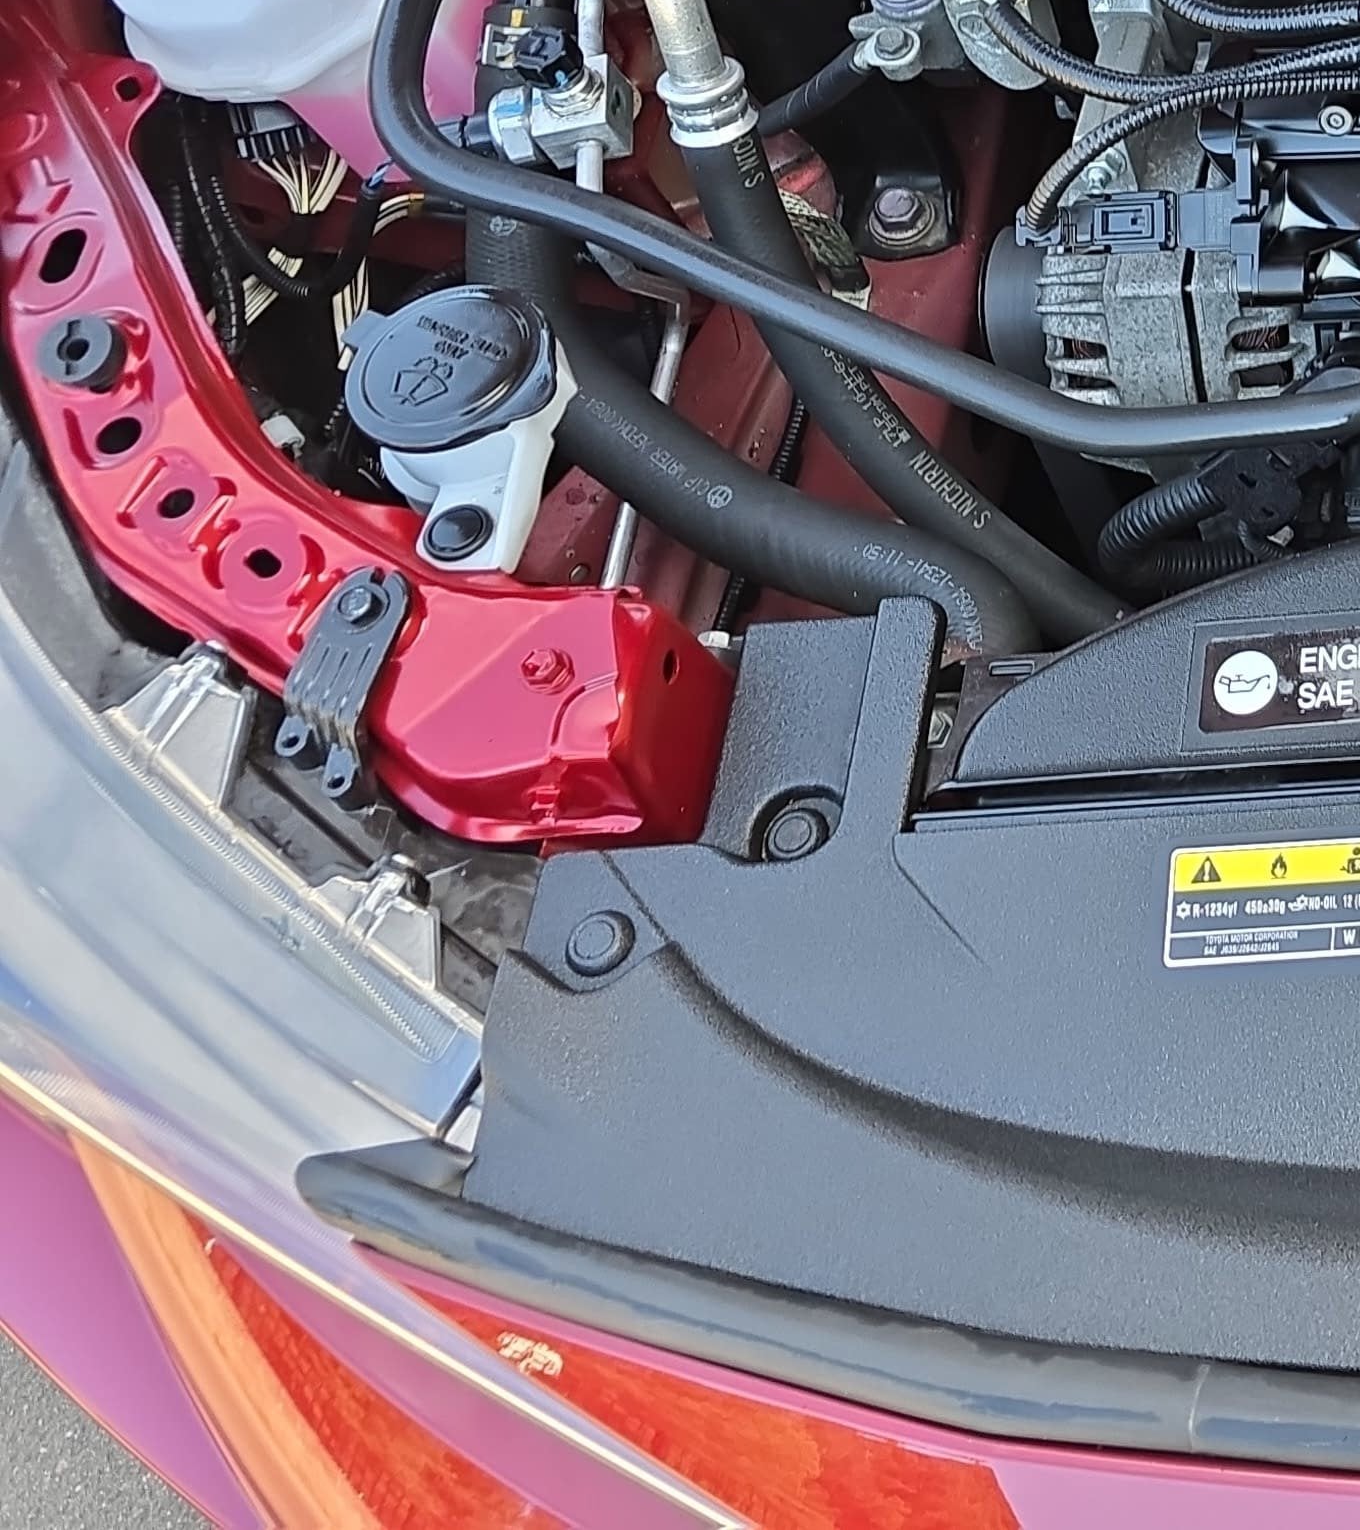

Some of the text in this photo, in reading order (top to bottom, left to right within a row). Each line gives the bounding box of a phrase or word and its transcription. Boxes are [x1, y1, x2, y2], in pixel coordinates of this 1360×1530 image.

[1298, 680, 1353, 710] SAE
[1192, 901, 1237, 918] R-1234yf
[1205, 930, 1299, 944] TOYOTA MOTOR CORPORATION
[1343, 929, 1357, 945] W
